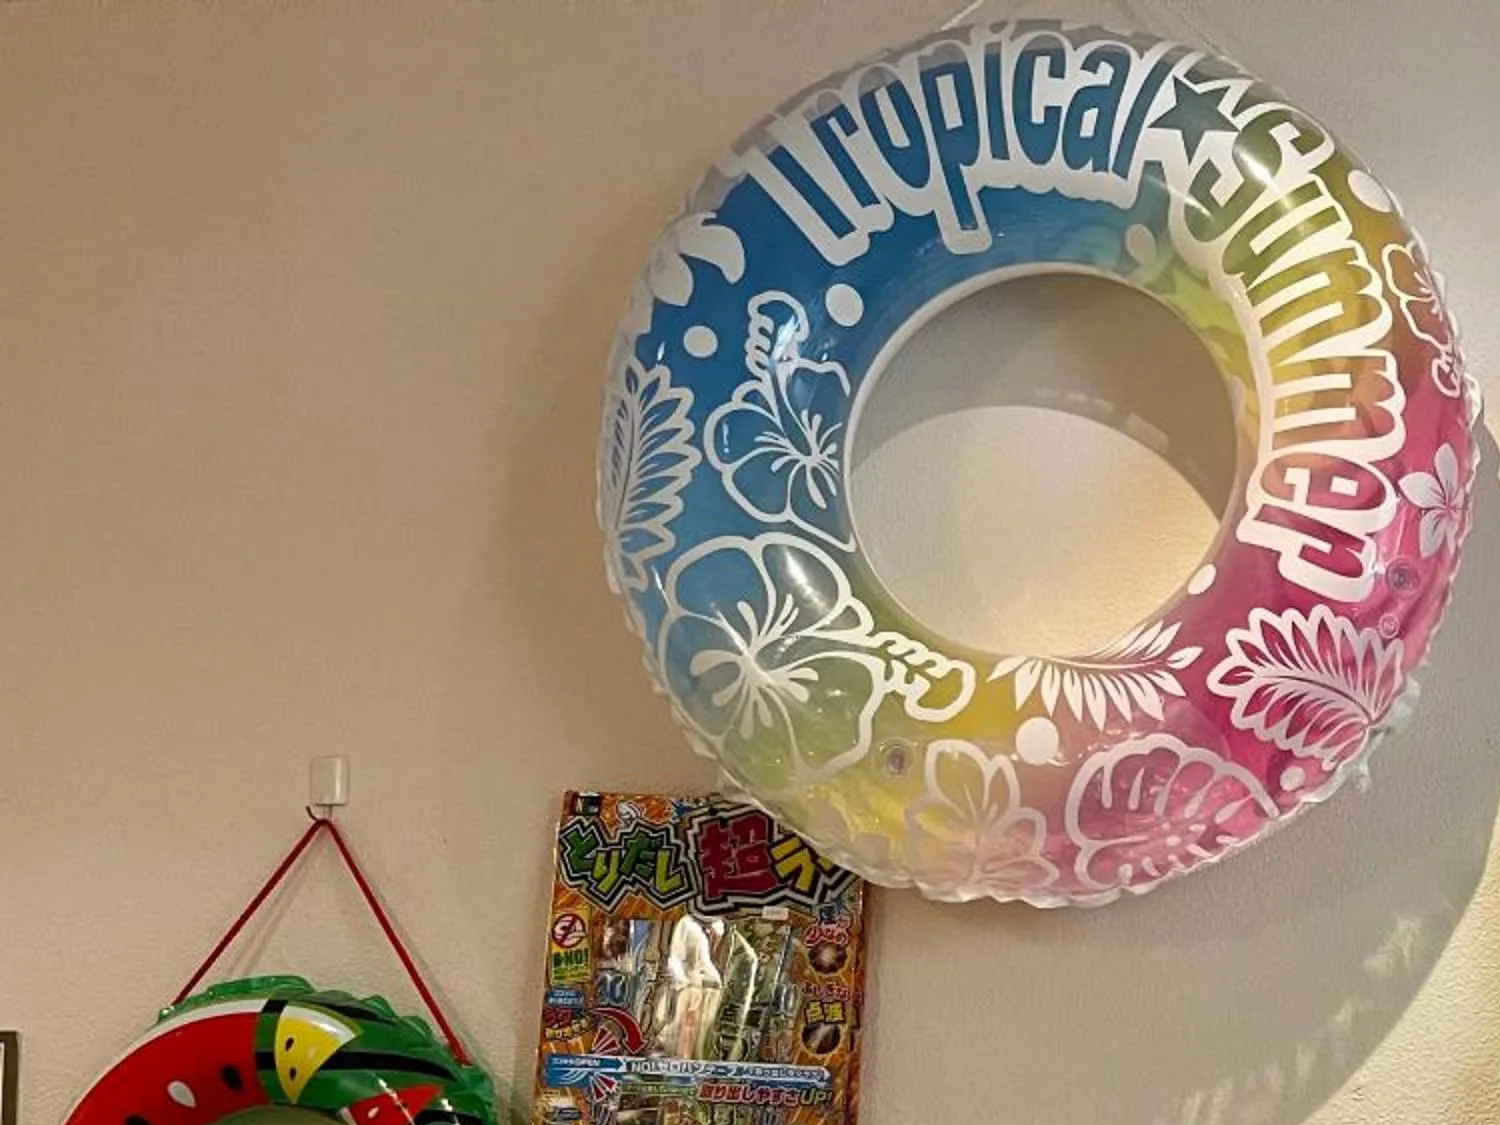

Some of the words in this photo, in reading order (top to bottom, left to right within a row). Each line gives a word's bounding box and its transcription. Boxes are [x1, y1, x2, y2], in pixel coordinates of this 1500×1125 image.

[735, 33, 1172, 262] Tropical
[563, 830, 683, 891] とりだし
[695, 812, 836, 898] 超ラ
